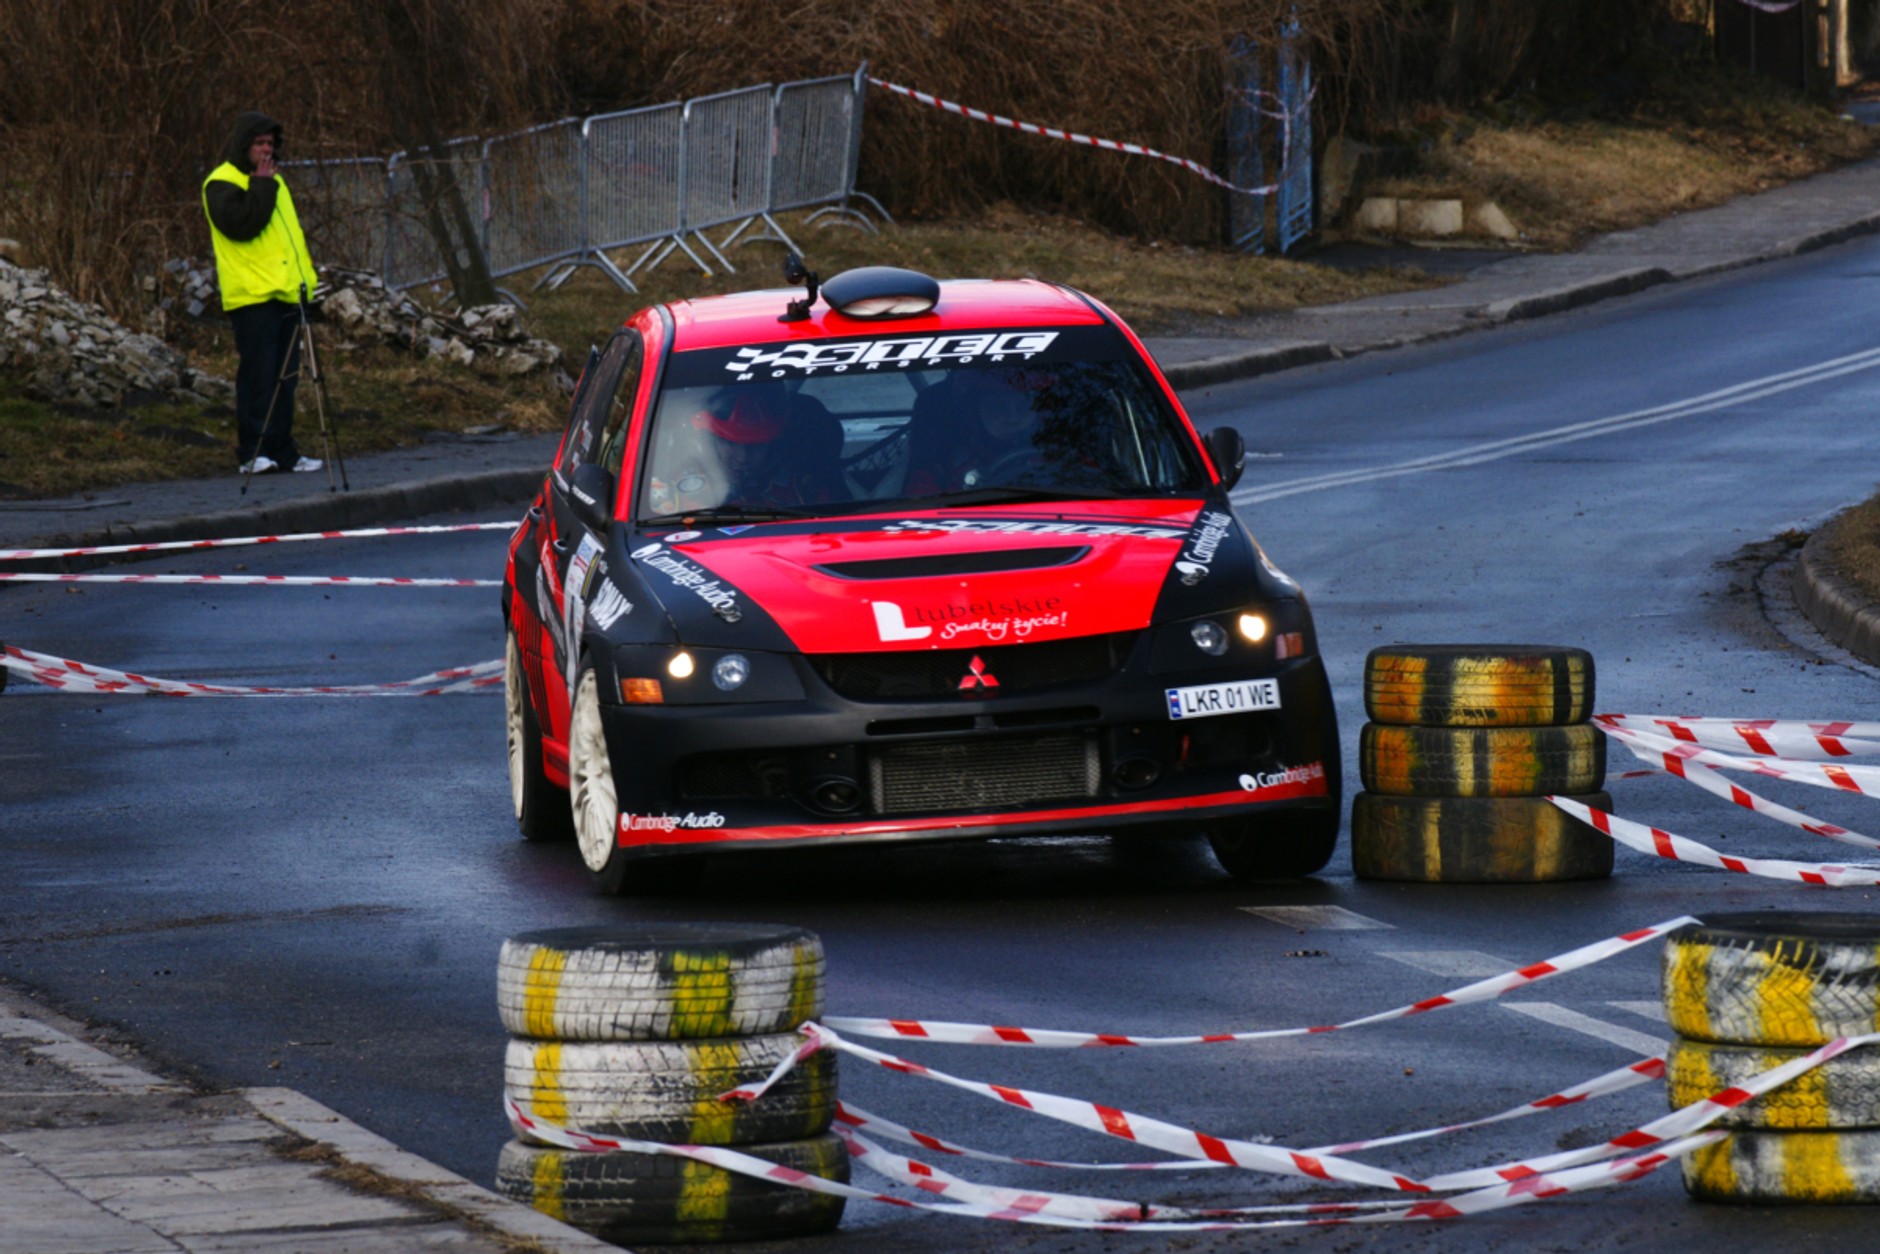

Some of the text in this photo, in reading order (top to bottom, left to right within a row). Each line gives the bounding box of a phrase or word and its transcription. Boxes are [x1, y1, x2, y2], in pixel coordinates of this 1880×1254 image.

[737, 352, 1035, 381] MOTORSPORT
[915, 597, 1061, 622] lubelskie
[940, 617, 1010, 640] Smakuj
[1184, 683, 1274, 713] LKR 01 WE
[681, 811, 725, 828] Audio
